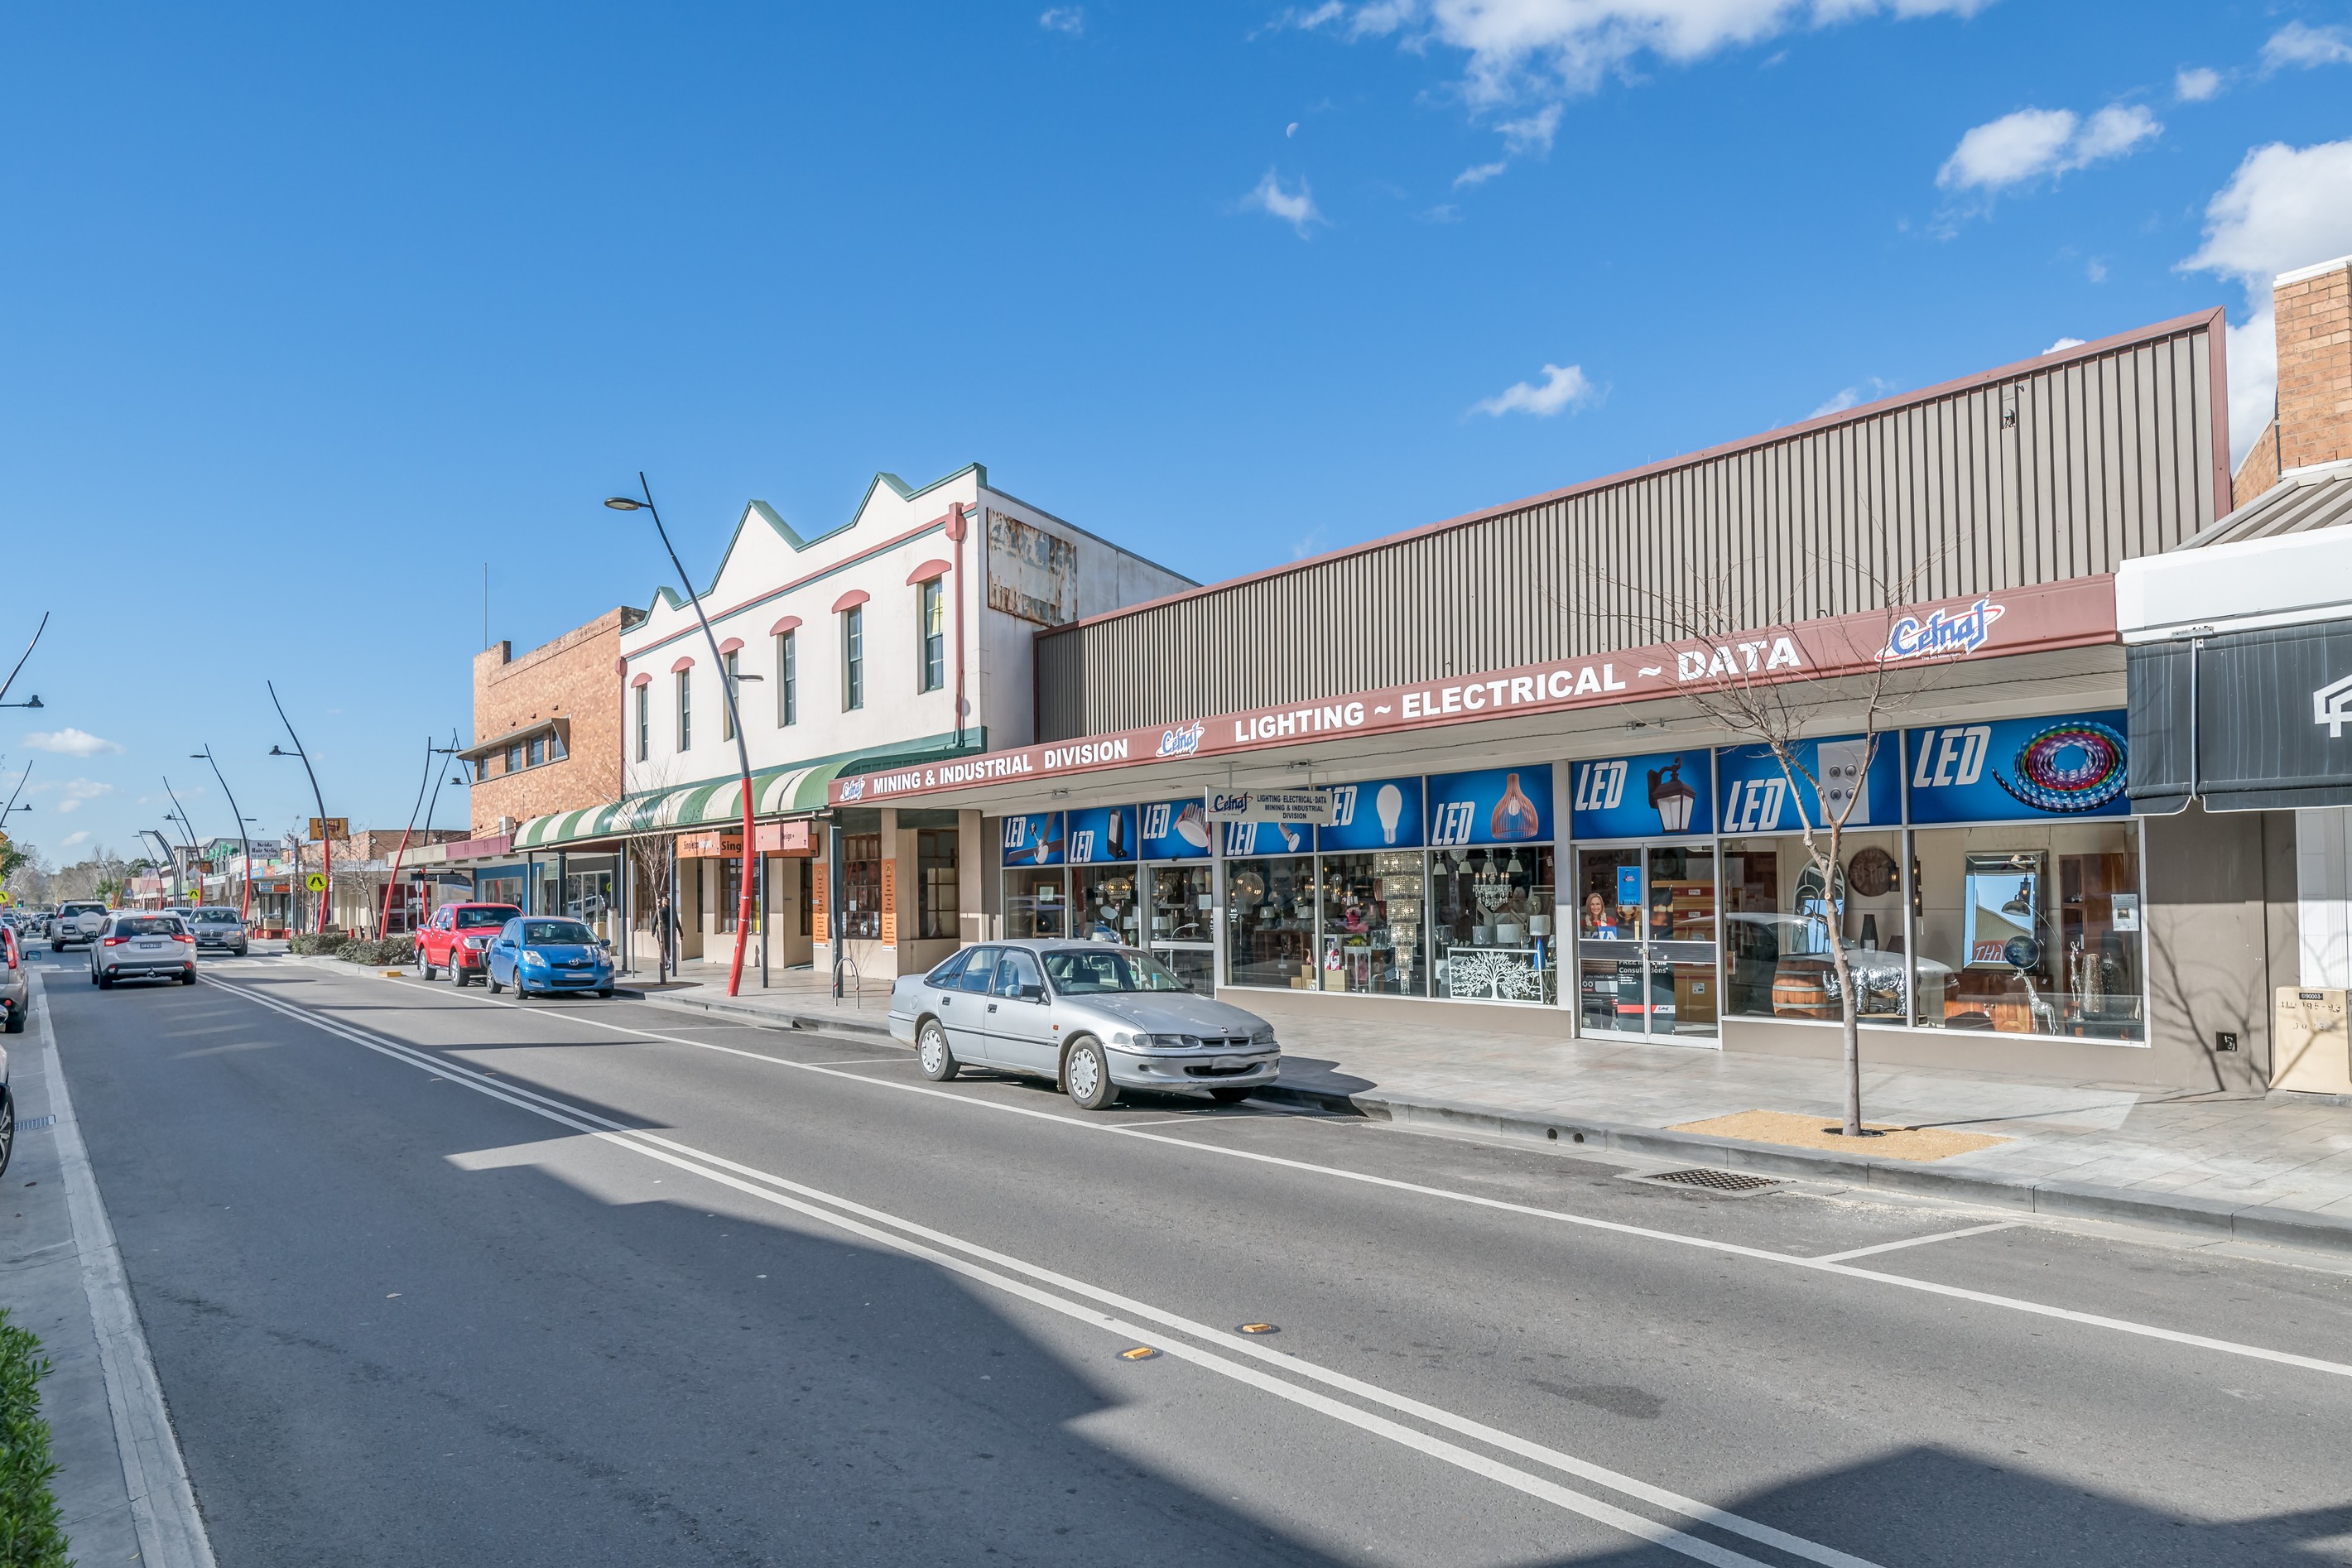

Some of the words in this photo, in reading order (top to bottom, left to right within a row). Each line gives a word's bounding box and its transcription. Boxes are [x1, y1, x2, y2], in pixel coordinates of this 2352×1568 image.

[1234, 701, 1364, 743] LIGHTING
[1402, 663, 1626, 719] ELECTRICAL
[1677, 637, 1801, 682] DATA
[873, 772, 921, 794] MINING
[925, 769, 936, 786] &
[940, 753, 1032, 784] INDUSTRIAL
[1044, 738, 1128, 769] DIVISION
[1913, 725, 1992, 788] LED
[1320, 786, 1357, 827] ED
[1575, 760, 1628, 811] LED
[1724, 777, 1787, 832] LED
[1004, 816, 1027, 849] LED
[1142, 803, 1171, 840] LED
[1226, 822, 1258, 856] LED
[1431, 801, 1476, 846] LED
[1070, 830, 1094, 863] LED
